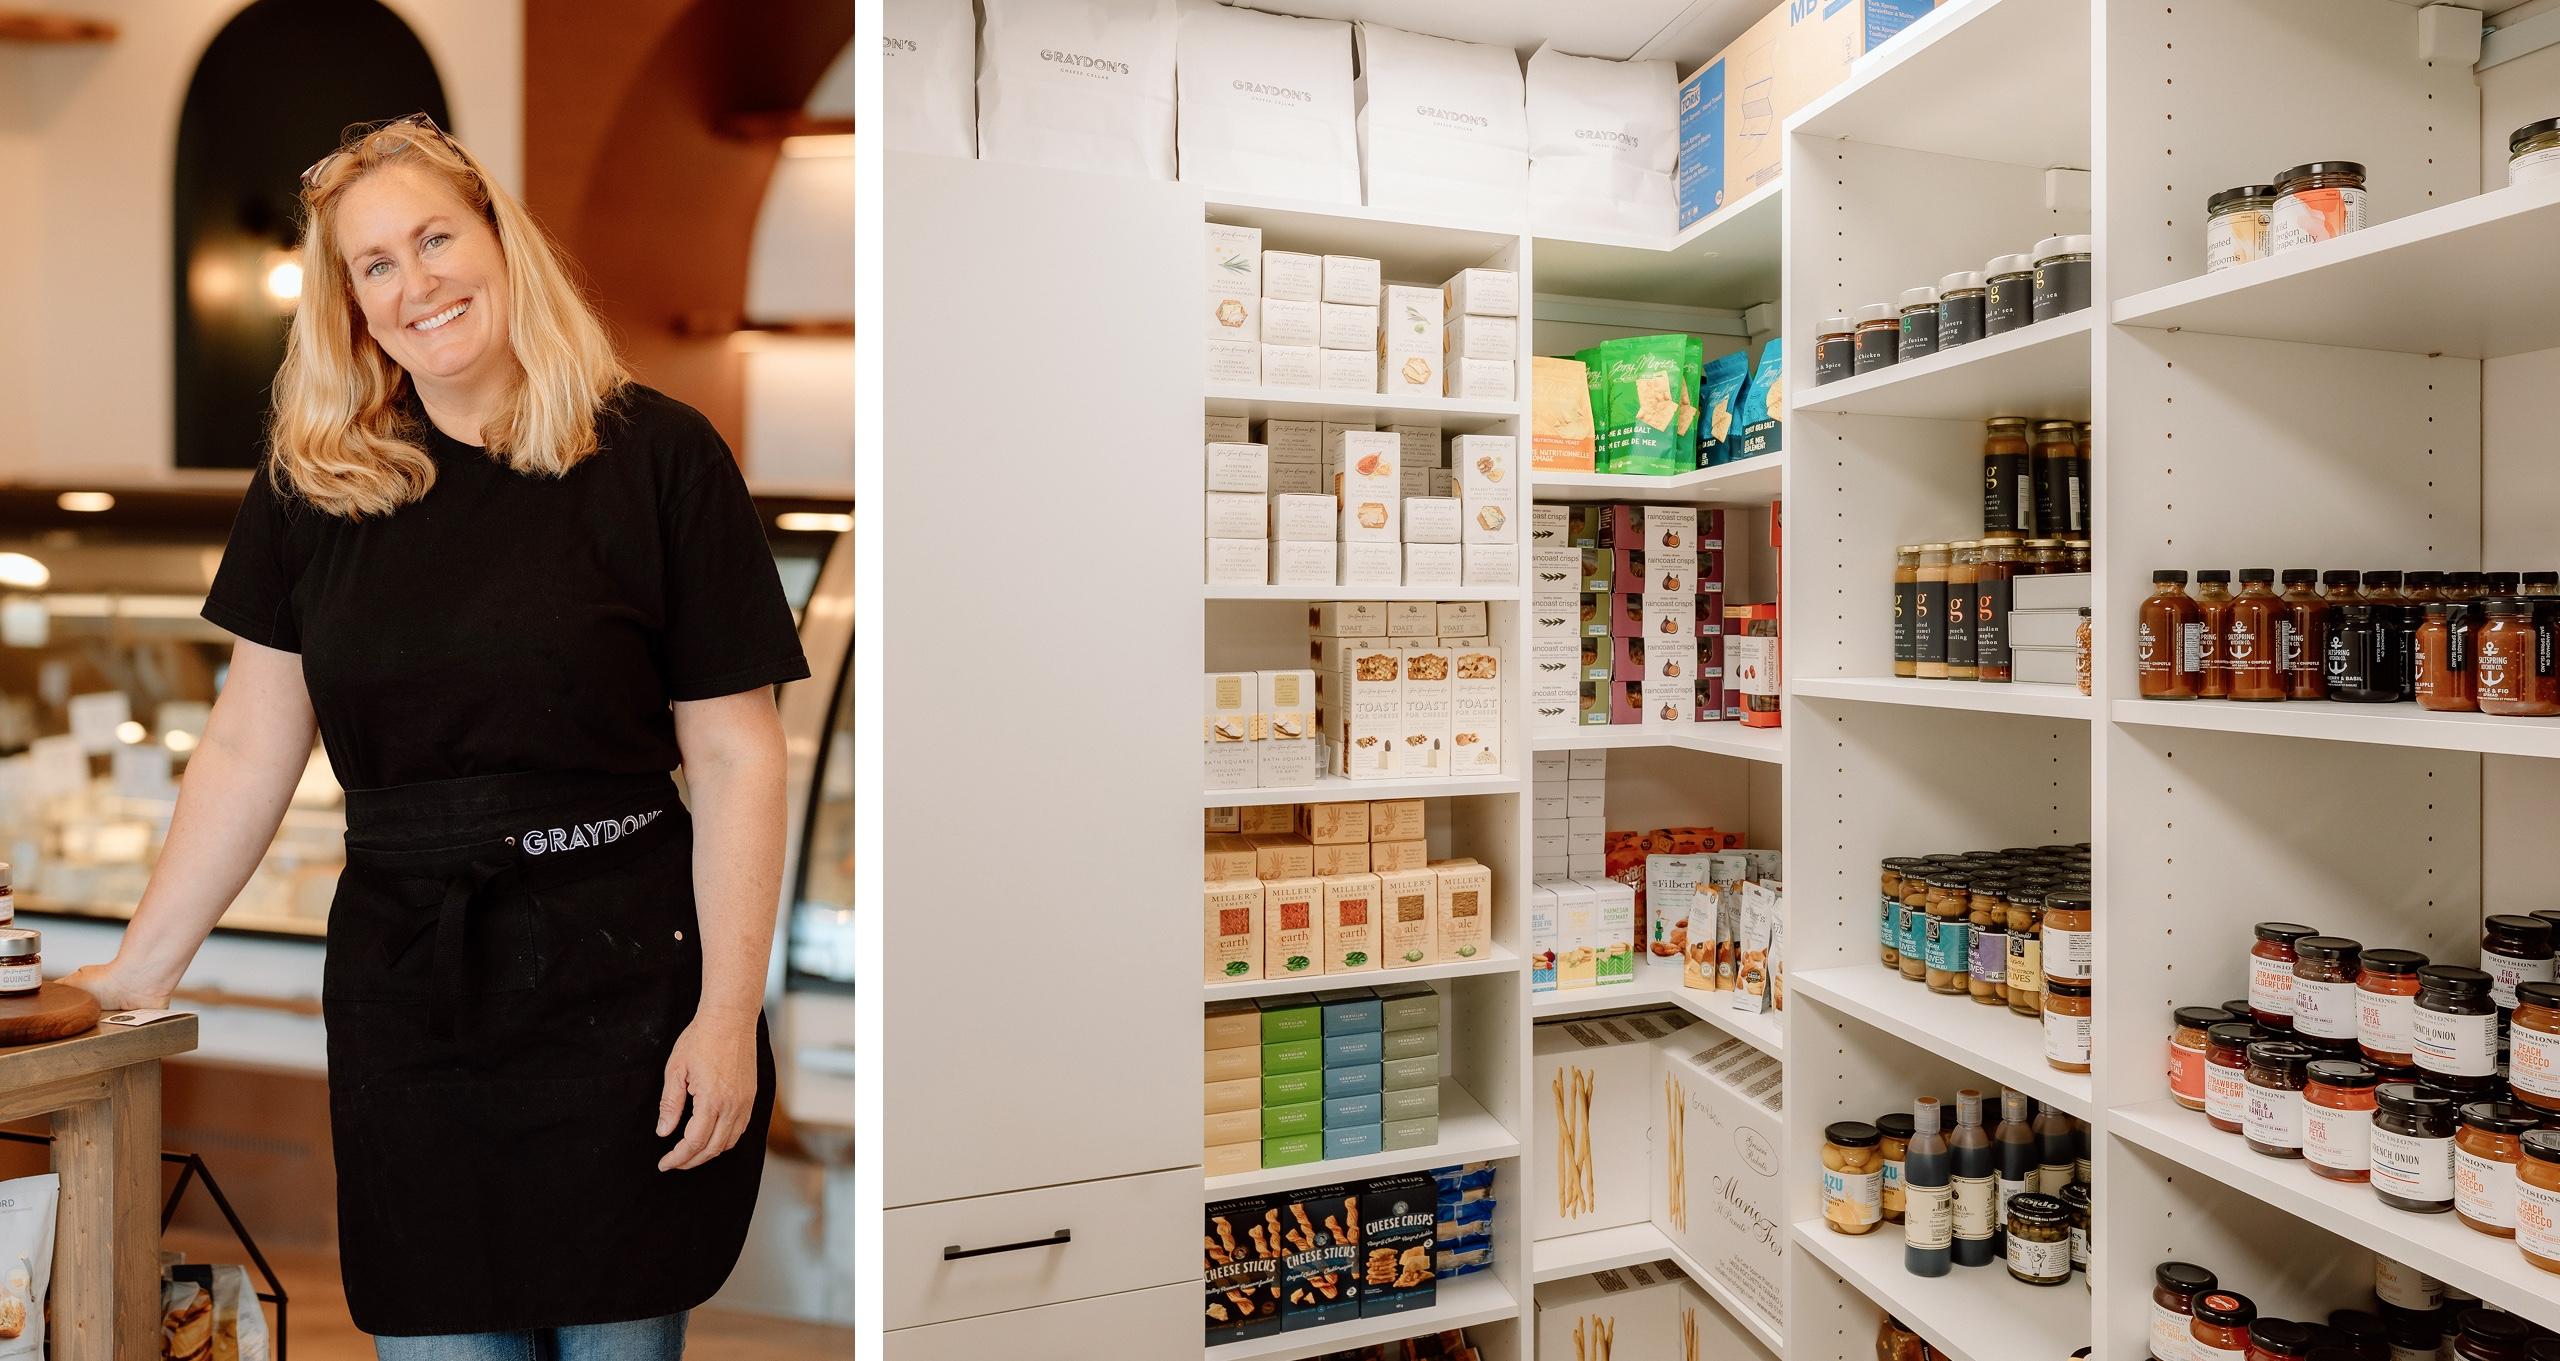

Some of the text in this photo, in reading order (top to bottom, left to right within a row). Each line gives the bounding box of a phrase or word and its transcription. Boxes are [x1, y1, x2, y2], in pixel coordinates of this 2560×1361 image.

[1040, 49, 1129, 75] GRAYDON'S
[1232, 79, 1312, 103] GRAYDON'S
[1416, 105, 1489, 128] GRAYDON'S
[1574, 128, 1639, 149] GRAYDON'S
[2296, 233, 2318, 246] Jelly
[2036, 269, 2045, 289] g
[1990, 285, 2000, 304] g
[1908, 336, 1928, 344] fusion
[1858, 352, 1881, 360] Chicken
[1825, 362, 1841, 371] Spice
[1623, 427, 1633, 435] SEA
[1634, 426, 1651, 435] SALT
[1642, 439, 1657, 447] MER
[1539, 449, 1589, 459] NUTRITIONNELLE
[1986, 466, 1998, 490] g
[1548, 511, 1567, 521] crisps
[1647, 513, 1695, 522] raincoast crisps
[1559, 554, 1580, 564] crisps
[1676, 557, 1695, 566] crisps
[1559, 600, 1578, 609] crisps
[1674, 600, 1693, 609] crisps
[1917, 593, 1927, 618] g
[1980, 595, 1993, 621] g
[1950, 598, 1963, 624] g
[1559, 644, 1579, 653] crisps
[1677, 644, 1695, 652] crisps
[2478, 656, 2508, 665] SALTSPRING
[1557, 689, 1577, 699] crisps
[1675, 688, 1693, 696] crisps
[1355, 702, 1399, 713] TOAST
[1406, 701, 1449, 711] TOAST
[1455, 698, 1497, 709] TOAST
[1390, 879, 1432, 890] MILLER'S
[1444, 876, 1486, 887] MILLER'S
[1272, 886, 1318, 897] MILLER'S
[1332, 883, 1376, 894] MILLER'S
[1212, 893, 1258, 903] MILLER'S
[1604, 913, 1629, 921] ROSEMARY
[1404, 923, 1419, 934] ale
[1458, 918, 1472, 929] ale
[1281, 930, 1309, 943] earth
[1340, 926, 1367, 939] earth
[1220, 936, 1249, 949] earth
[2488, 955, 2537, 968] PROVISIONS
[2501, 969, 2521, 980] FIG &
[2255, 978, 2292, 991] ELDERFLOW
[2298, 991, 2308, 1001] FIG
[2363, 1006, 2379, 1017] ROSE
[2363, 1014, 2381, 1026] PETAL
[2432, 1028, 2456, 1041] ONION
[2518, 1042, 2542, 1057] PEACH
[2513, 1051, 2550, 1068] PROSECCO
[2251, 1098, 2268, 1111] FIG &
[2309, 1119, 2326, 1131] ROSE
[2309, 1128, 2328, 1141] PETAL
[2394, 1150, 2420, 1166] ONION
[2457, 1166, 2477, 1181] PEACH
[1713, 1175, 1762, 1222] Mario
[2520, 1200, 2544, 1216] PEACH
[1366, 1213, 1434, 1236] CHEESE CRISPS
[1286, 1246, 1356, 1269] CHEESE STICKS
[1204, 1259, 1276, 1283] CHEESE STICKS
